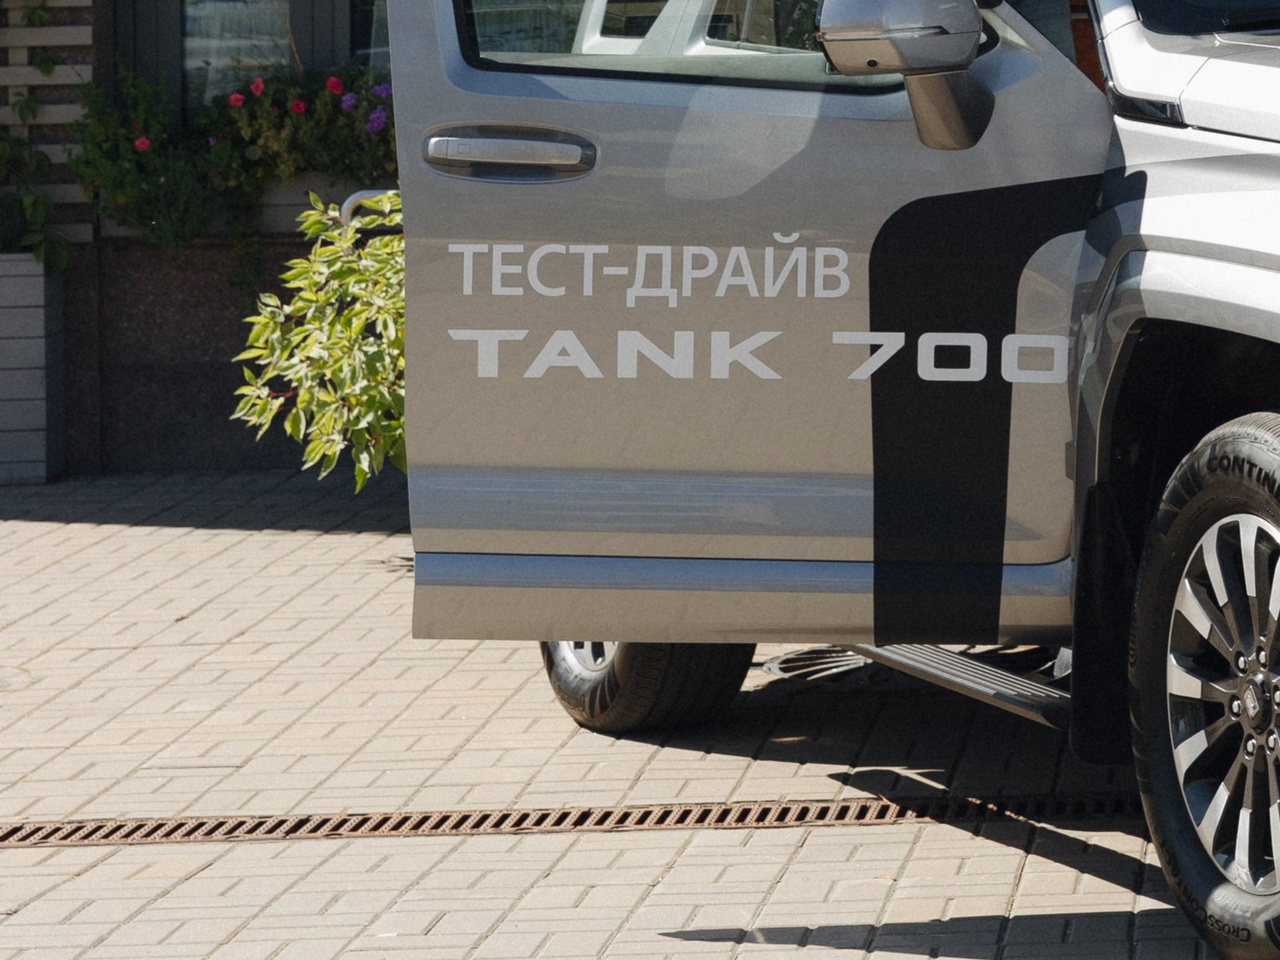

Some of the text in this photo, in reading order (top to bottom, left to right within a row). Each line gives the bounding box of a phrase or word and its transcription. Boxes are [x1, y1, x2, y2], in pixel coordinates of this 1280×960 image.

[448, 232, 851, 308] ТЕСТ-ДРАЙВ
[447, 329, 1070, 384] TANK 700
